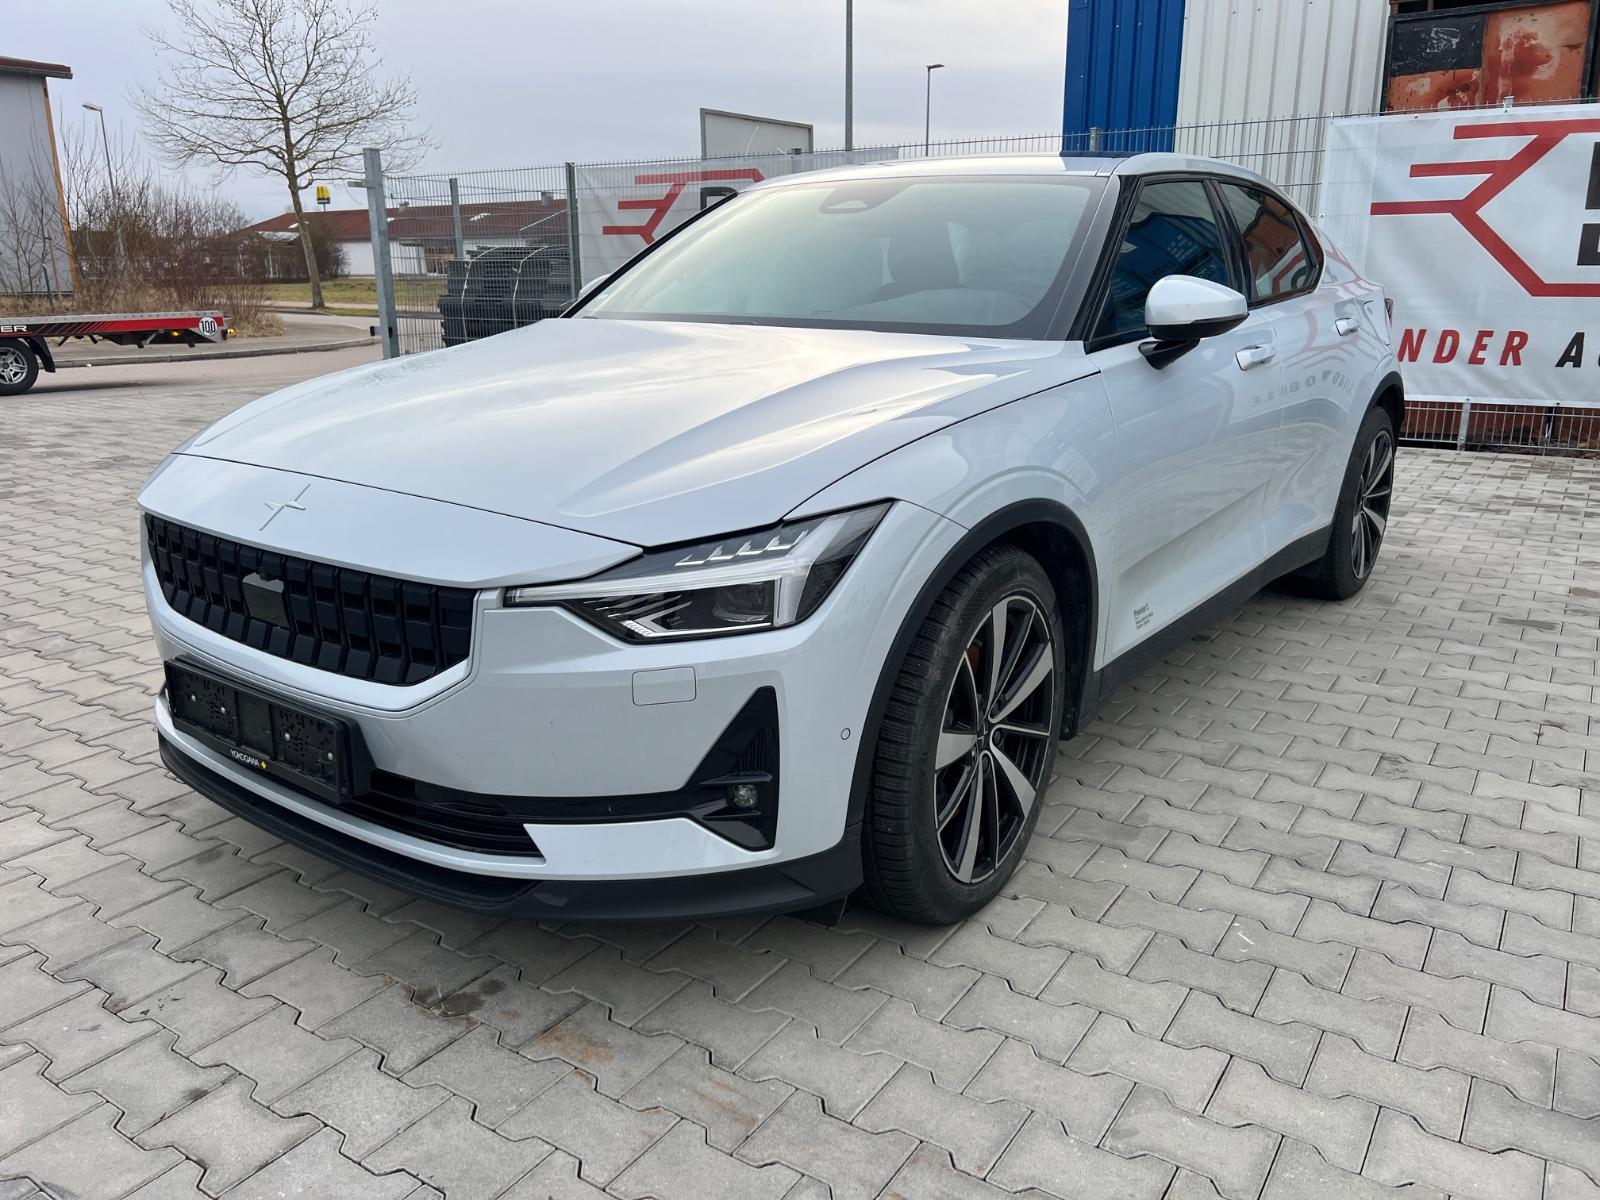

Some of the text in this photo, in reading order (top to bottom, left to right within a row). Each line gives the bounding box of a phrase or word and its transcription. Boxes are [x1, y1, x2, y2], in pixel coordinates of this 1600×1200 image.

[0, 325, 28, 333] ER
[201, 320, 216, 333] 100
[1397, 328, 1600, 369] NDER A
